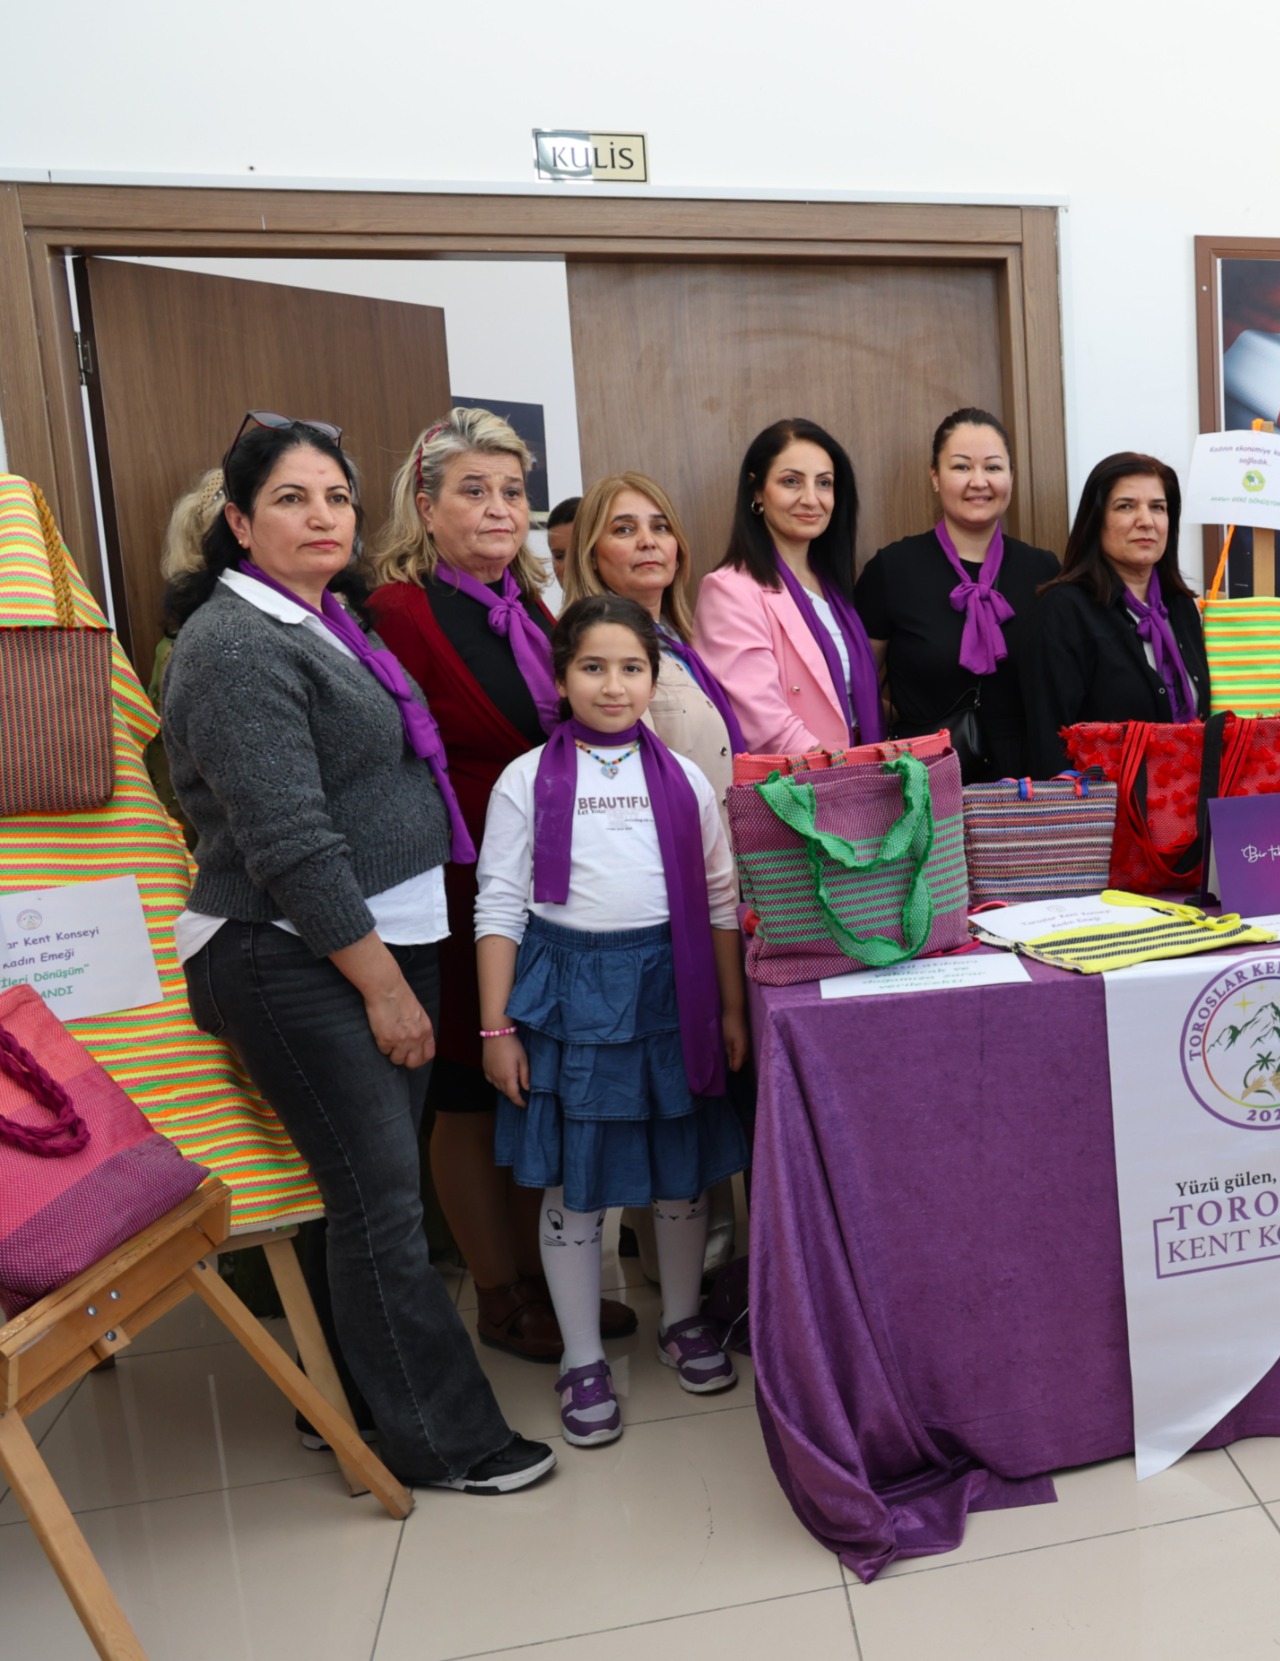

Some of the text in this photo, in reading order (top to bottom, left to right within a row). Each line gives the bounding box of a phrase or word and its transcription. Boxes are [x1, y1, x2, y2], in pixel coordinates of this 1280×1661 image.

[551, 141, 635, 170] KULİS
[577, 796, 650, 810] BEAUTIFU
[23, 935, 51, 947] Kent
[56, 926, 100, 942] Konseyi
[40, 948, 75, 963] Emeği
[41, 985, 74, 1000] ANDI
[1188, 969, 1249, 1061] TOROSLAR
[1175, 1177, 1220, 1197] Yüzü
[1224, 1170, 1278, 1194] gülen,
[1167, 1229, 1251, 1264] KENT
